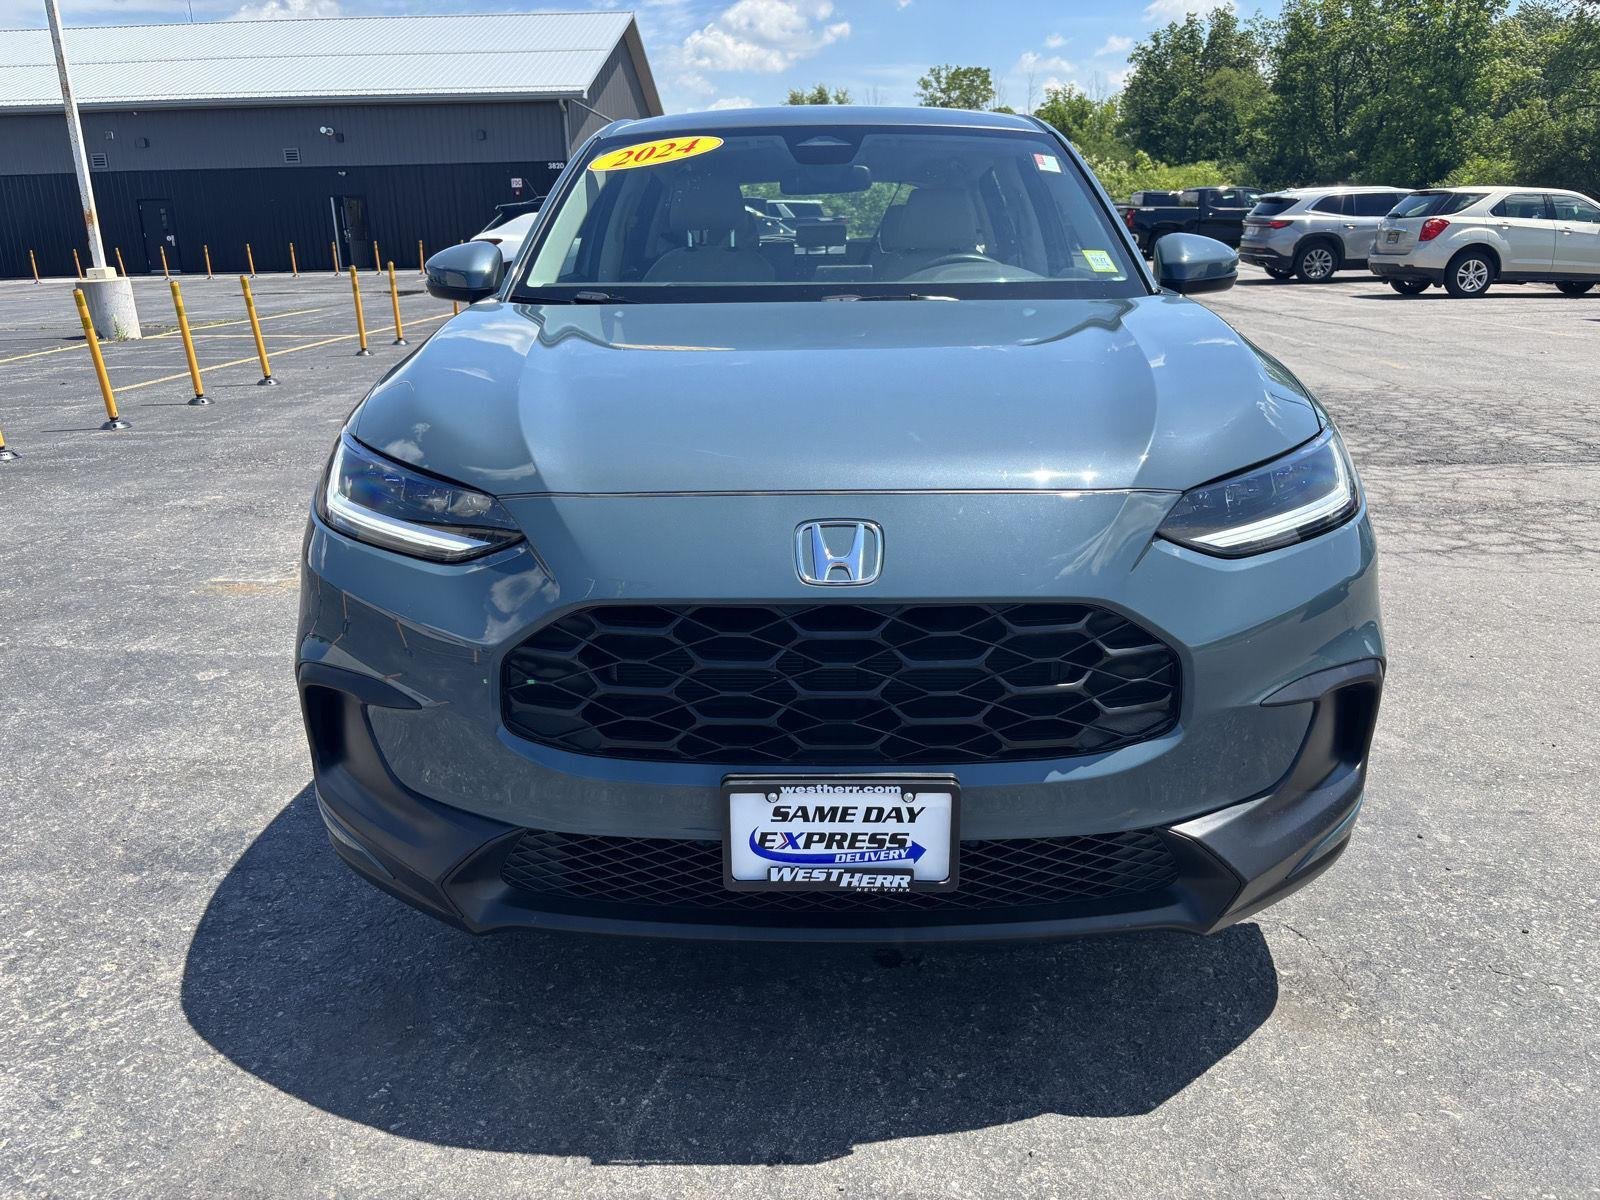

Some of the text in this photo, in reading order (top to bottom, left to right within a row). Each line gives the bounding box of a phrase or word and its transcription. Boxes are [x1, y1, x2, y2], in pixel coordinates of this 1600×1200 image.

[611, 138, 701, 167] 2024
[547, 162, 565, 170] 3820
[780, 785, 902, 794] westherr.com
[771, 806, 926, 823] SAME DAY
[758, 832, 910, 850] EXPRESS
[834, 849, 909, 864] DELIVERY
